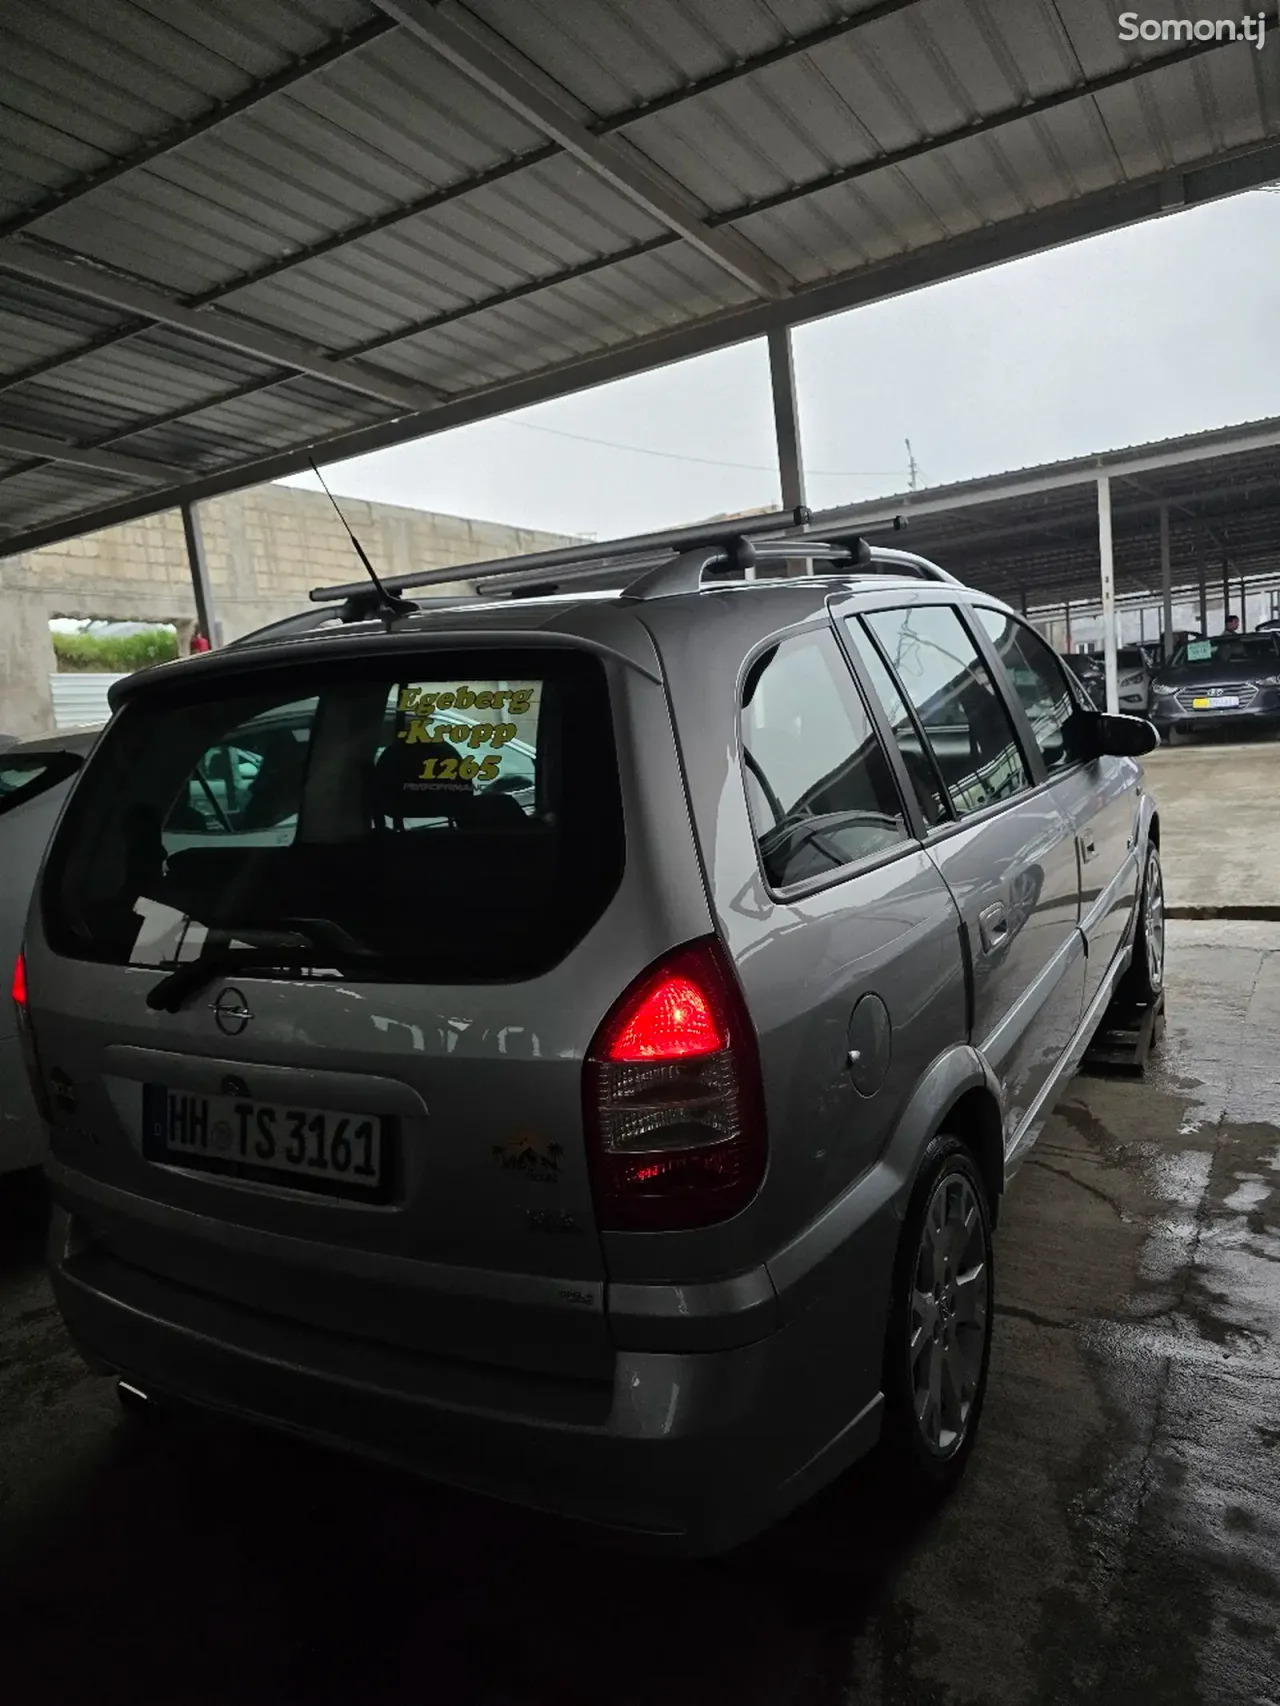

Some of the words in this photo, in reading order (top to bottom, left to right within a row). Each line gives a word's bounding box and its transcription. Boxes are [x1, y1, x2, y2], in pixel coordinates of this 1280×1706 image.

[398, 686, 534, 716] Egeberg
[397, 718, 518, 749] -Kropp
[418, 755, 502, 781] 1265
[169, 1094, 208, 1148] HH
[235, 1104, 277, 1160] TS
[285, 1110, 376, 1176] 3161
